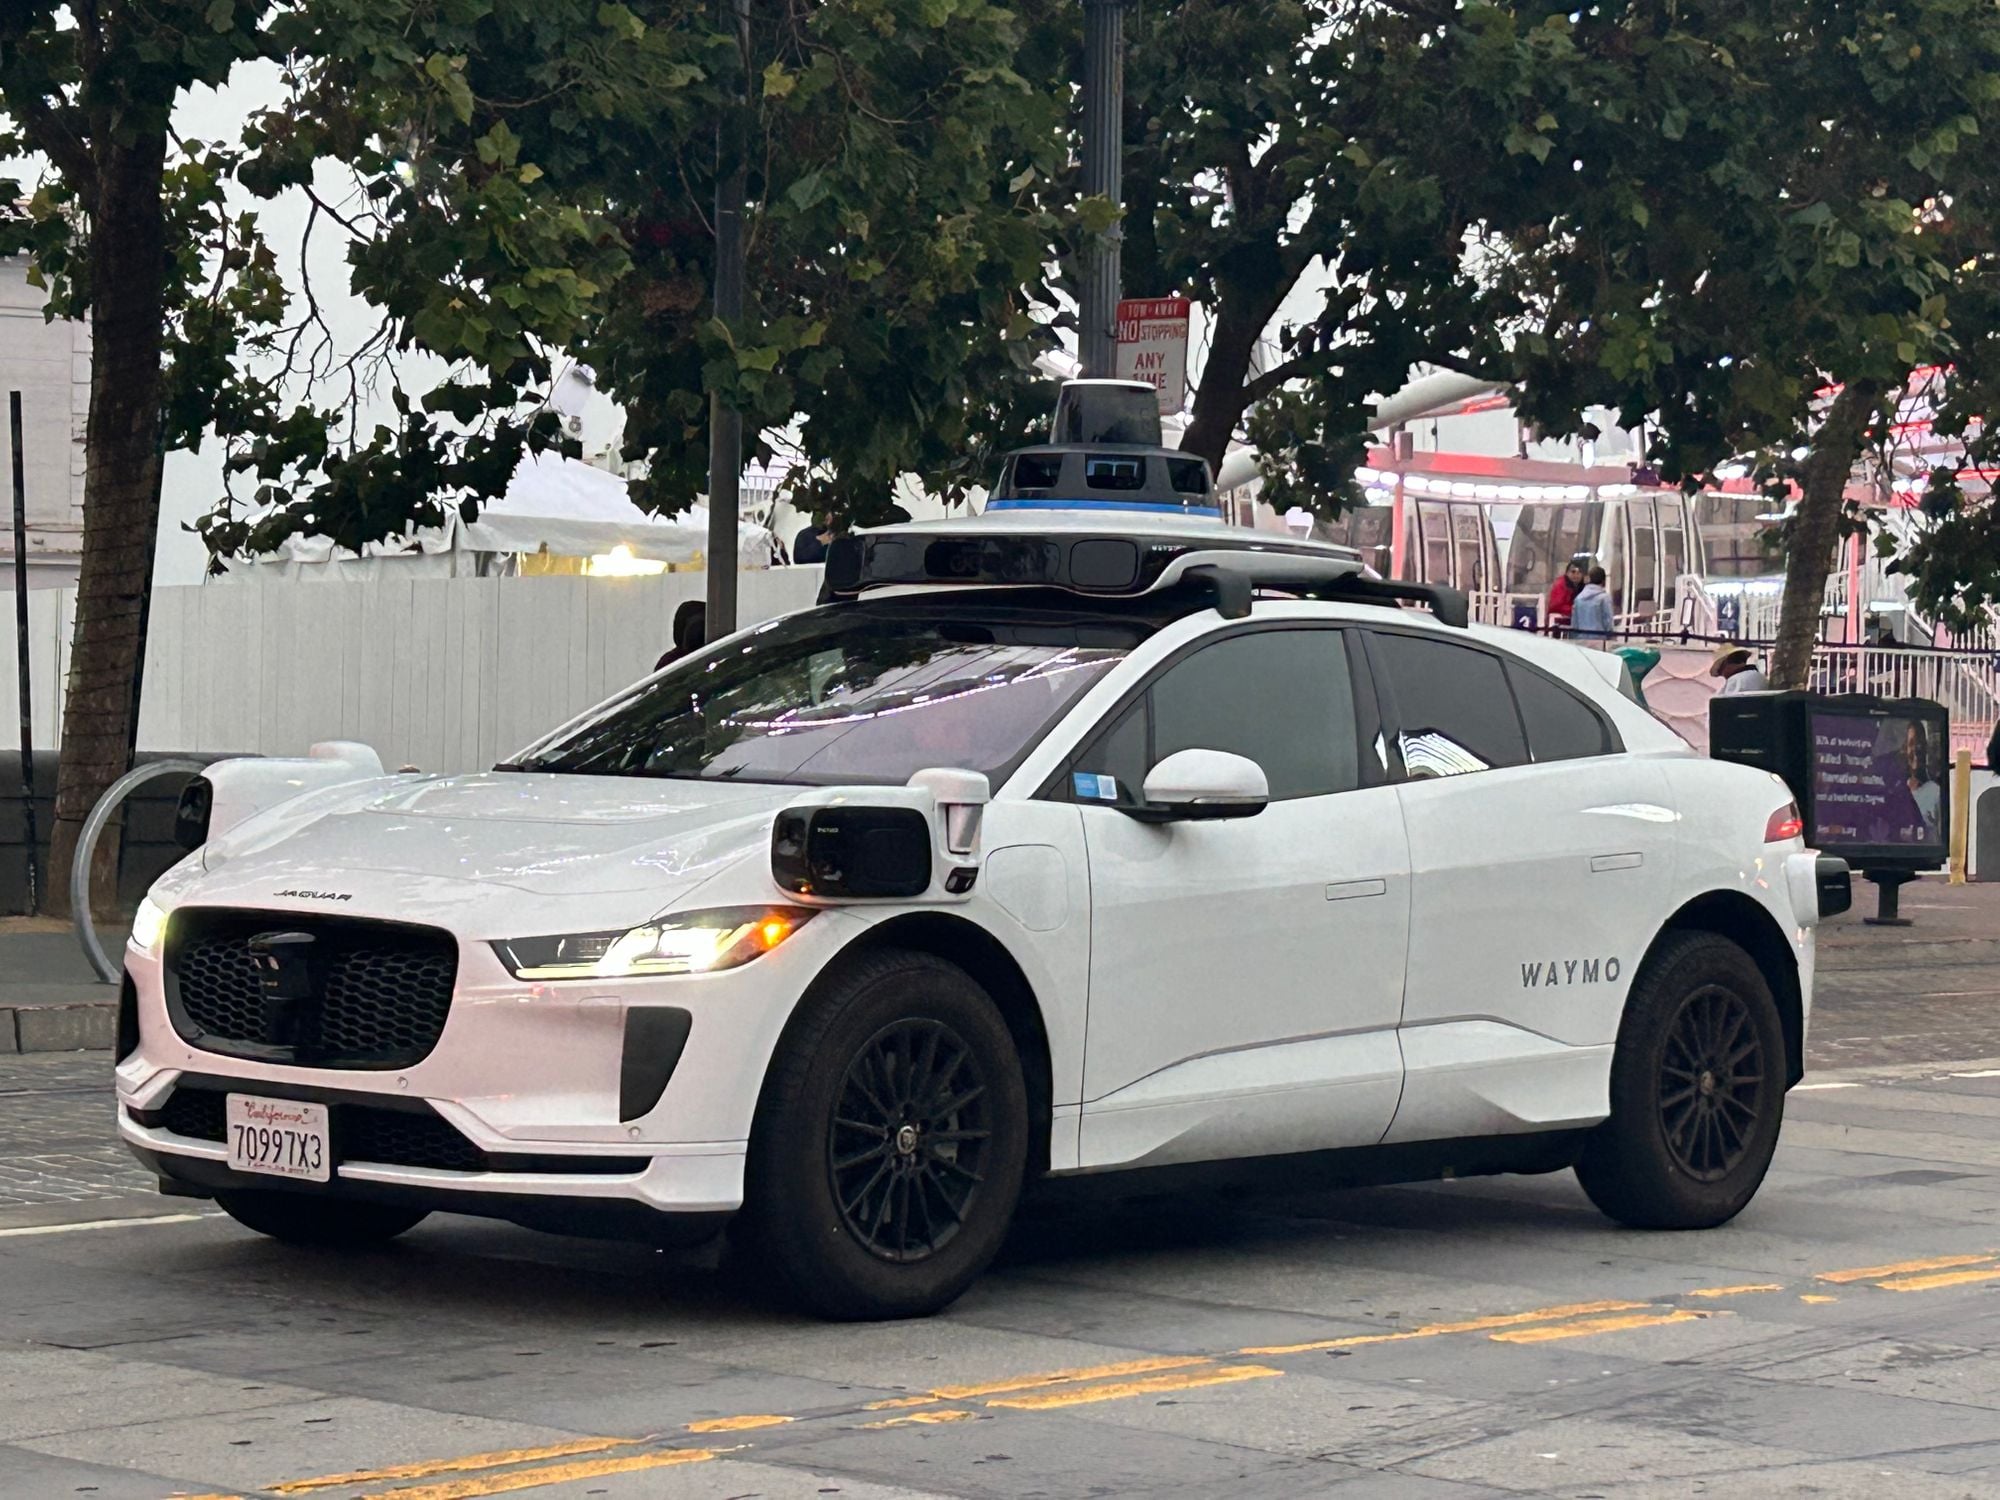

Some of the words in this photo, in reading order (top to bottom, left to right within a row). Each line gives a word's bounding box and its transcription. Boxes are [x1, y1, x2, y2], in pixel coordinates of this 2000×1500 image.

[1118, 320, 1138, 341] NO
[1141, 323, 1186, 341] STOPPING
[1135, 352, 1165, 370] ANY
[1722, 601, 1735, 618] 4
[273, 889, 353, 902] JAGUAR
[1521, 957, 1620, 988] WAYMO
[248, 1102, 302, 1125] California
[234, 1125, 321, 1169] 70997X3
